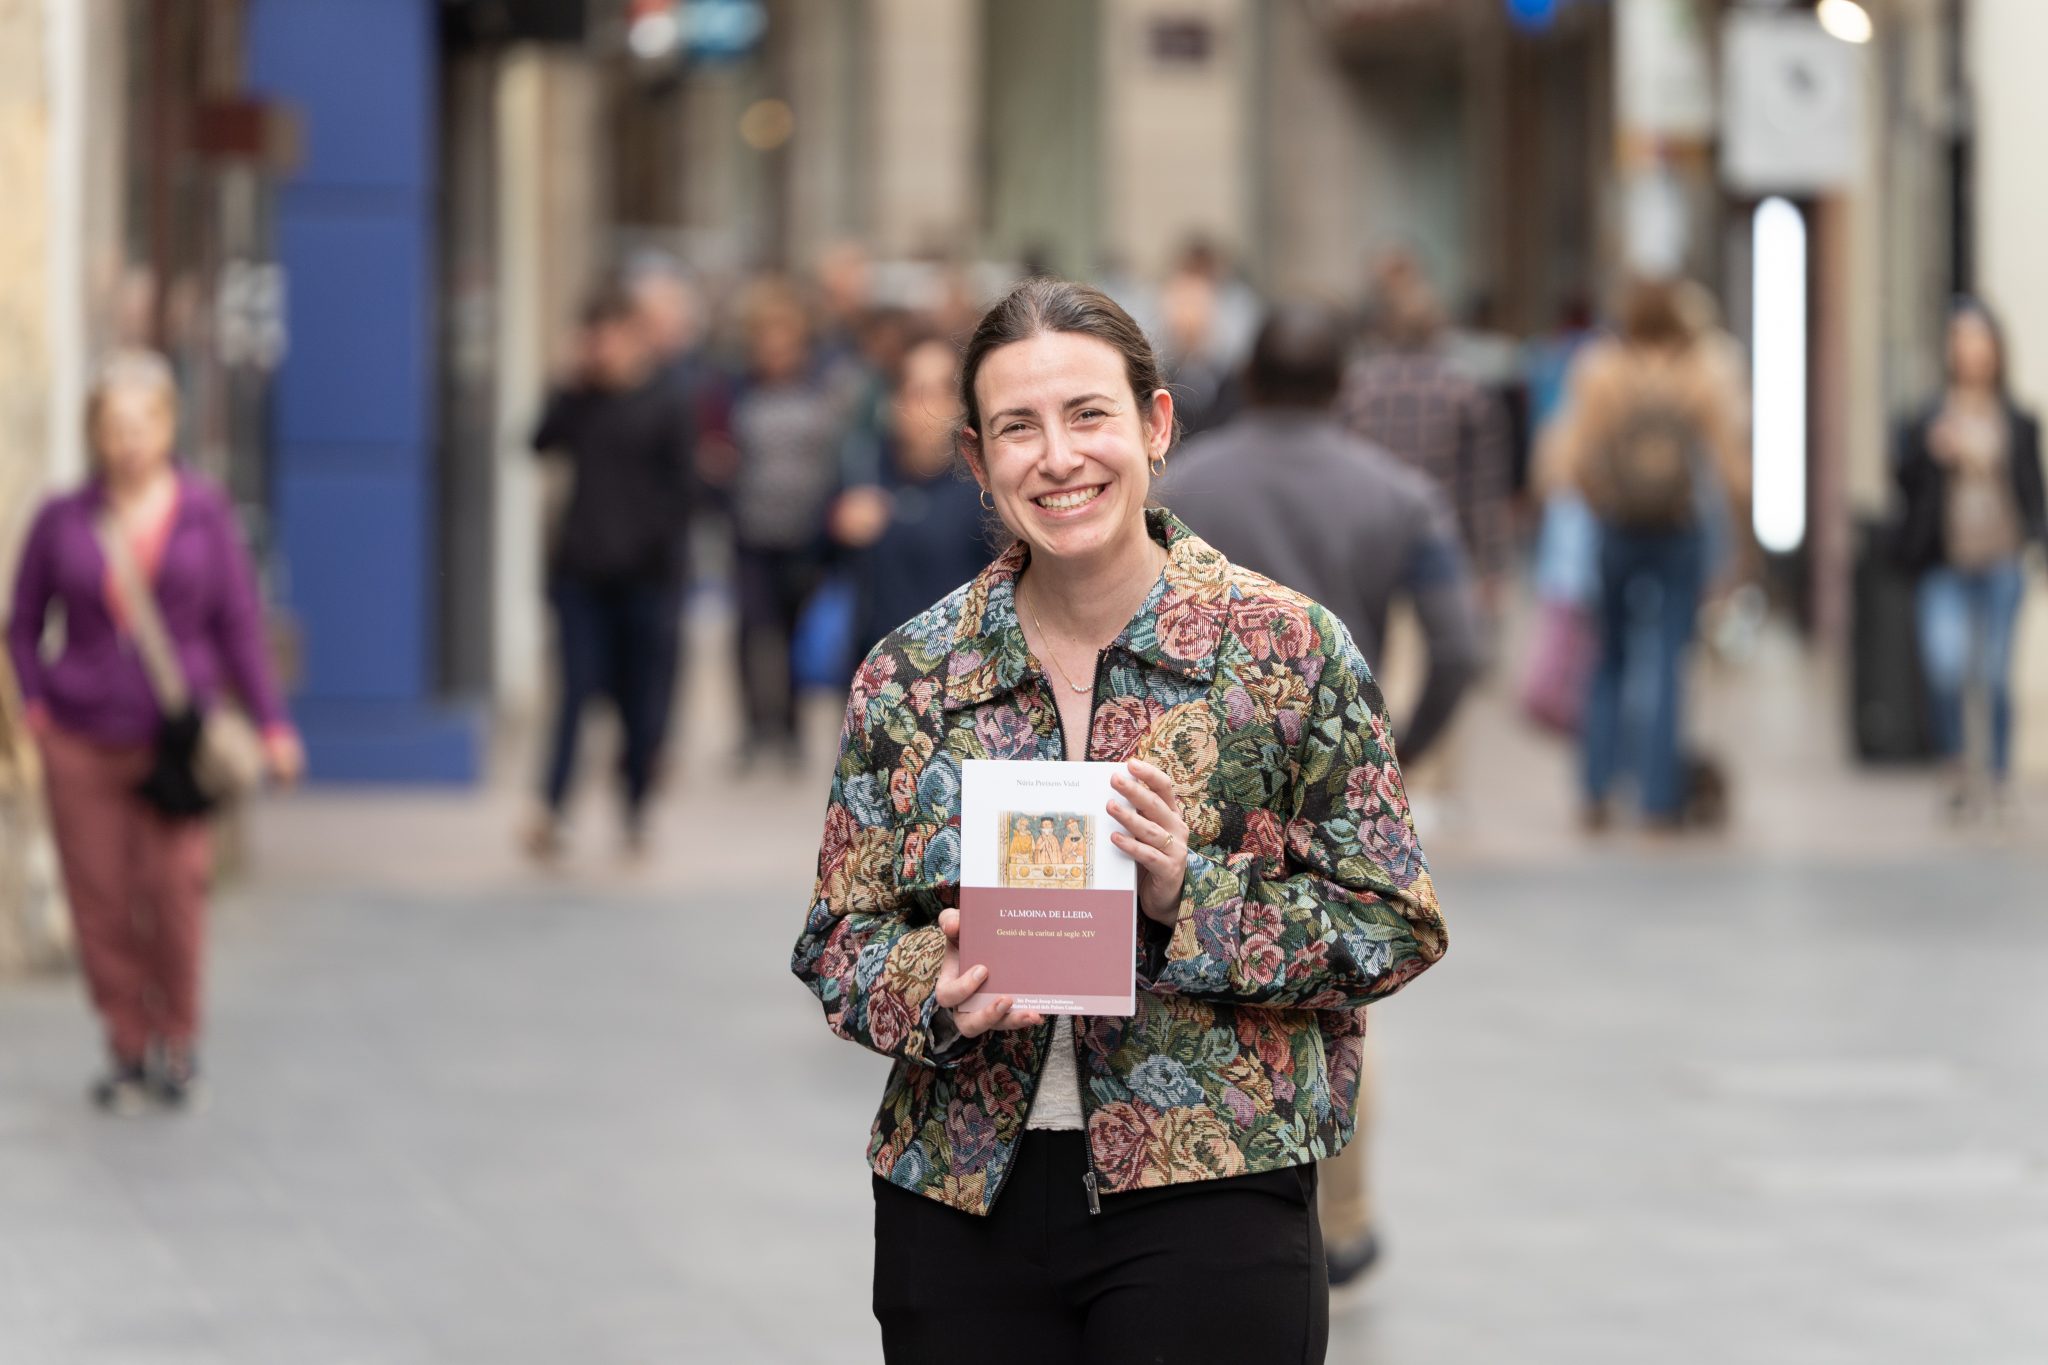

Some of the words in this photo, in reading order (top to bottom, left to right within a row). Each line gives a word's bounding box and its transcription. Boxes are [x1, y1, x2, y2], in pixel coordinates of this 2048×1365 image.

[1048, 910, 1061, 919] DE
[1062, 910, 1094, 919] LLEIDA
[996, 928, 1018, 937] Gestió
[1018, 929, 1027, 937] de
[1027, 929, 1034, 937] la
[1034, 929, 1055, 937] caritat
[1056, 929, 1063, 937] al
[1064, 930, 1080, 940] segle
[1081, 930, 1096, 938] XIV
